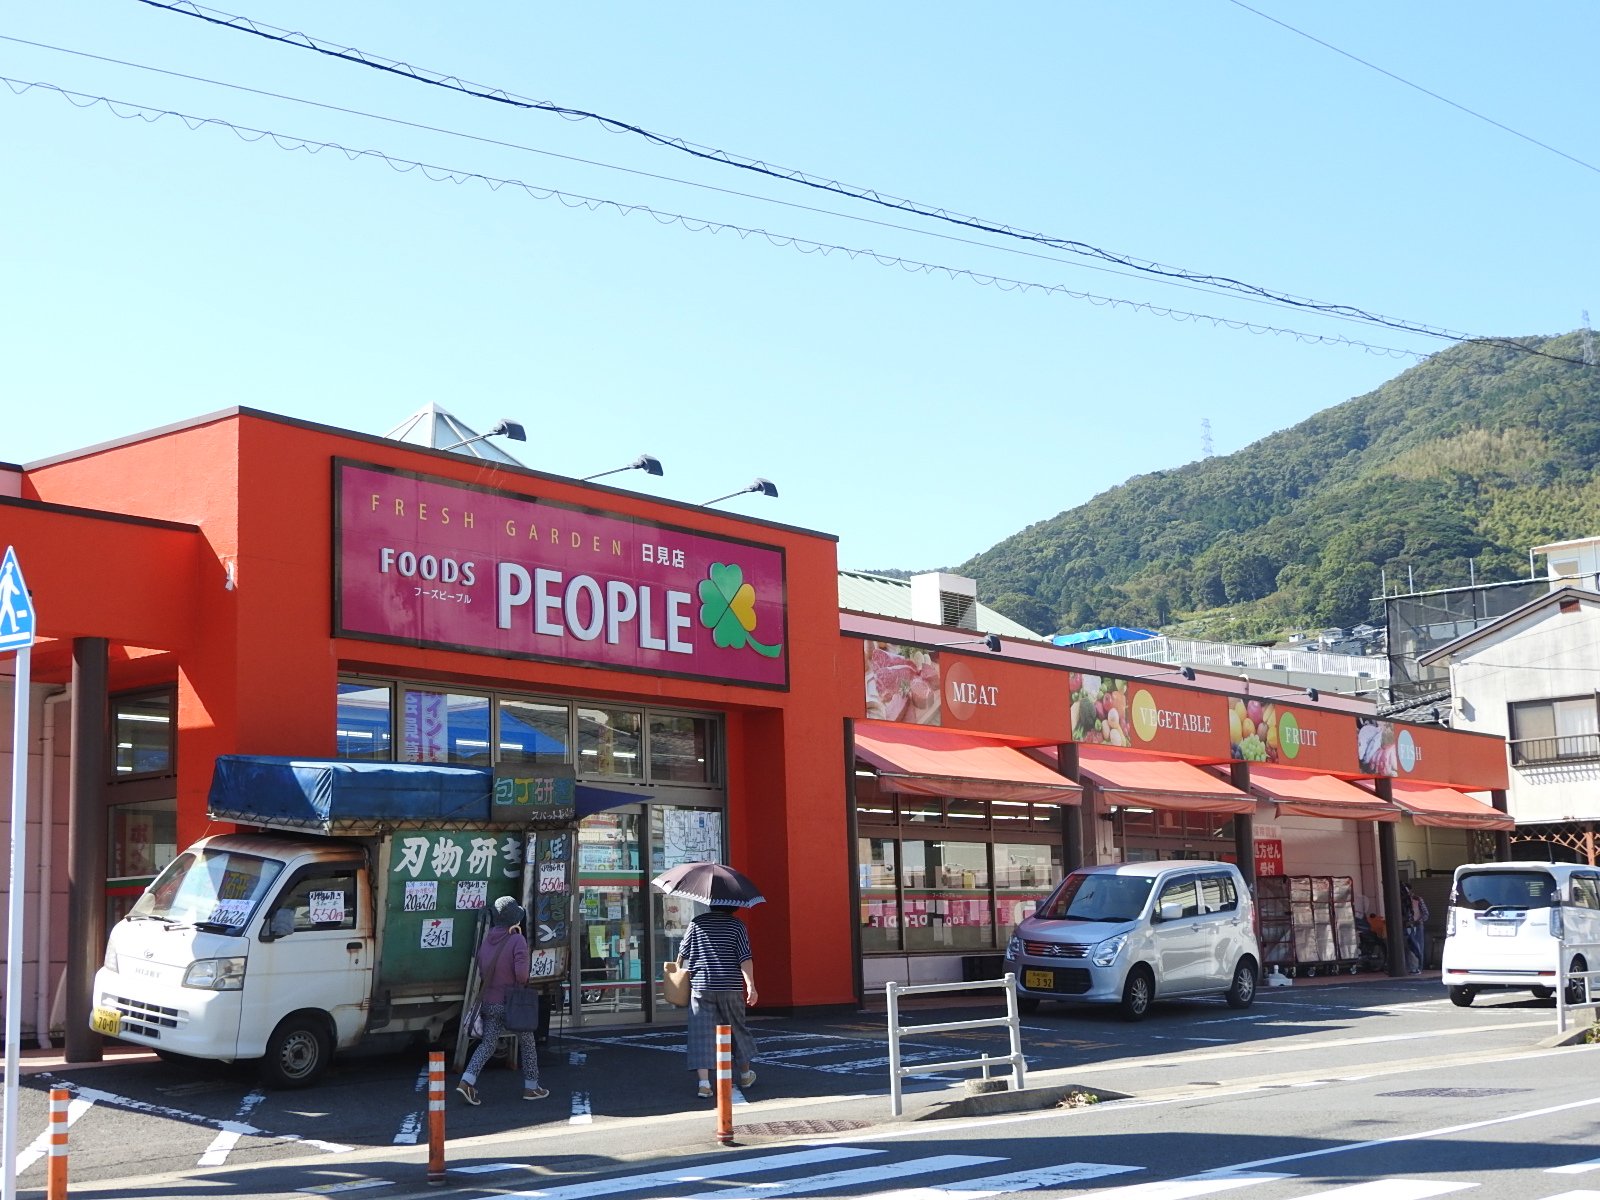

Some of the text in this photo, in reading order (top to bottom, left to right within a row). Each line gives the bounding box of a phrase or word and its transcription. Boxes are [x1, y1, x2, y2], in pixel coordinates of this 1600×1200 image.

[371, 494, 621, 556] FRESH GARDEN
[641, 543, 685, 569] 日見店
[380, 547, 694, 655] FOODS PEOPLE
[952, 681, 998, 707] MEAT
[1139, 707, 1212, 733] VEGETABLE
[1285, 726, 1317, 747] FRUIT
[1399, 743, 1422, 761] FISH
[494, 778, 572, 804] 包丁研ぎ
[1260, 861, 1275, 876] 受付
[310, 907, 343, 921] 550円
[423, 928, 450, 946] 受付
[98, 1016, 117, 1034] 70-01
